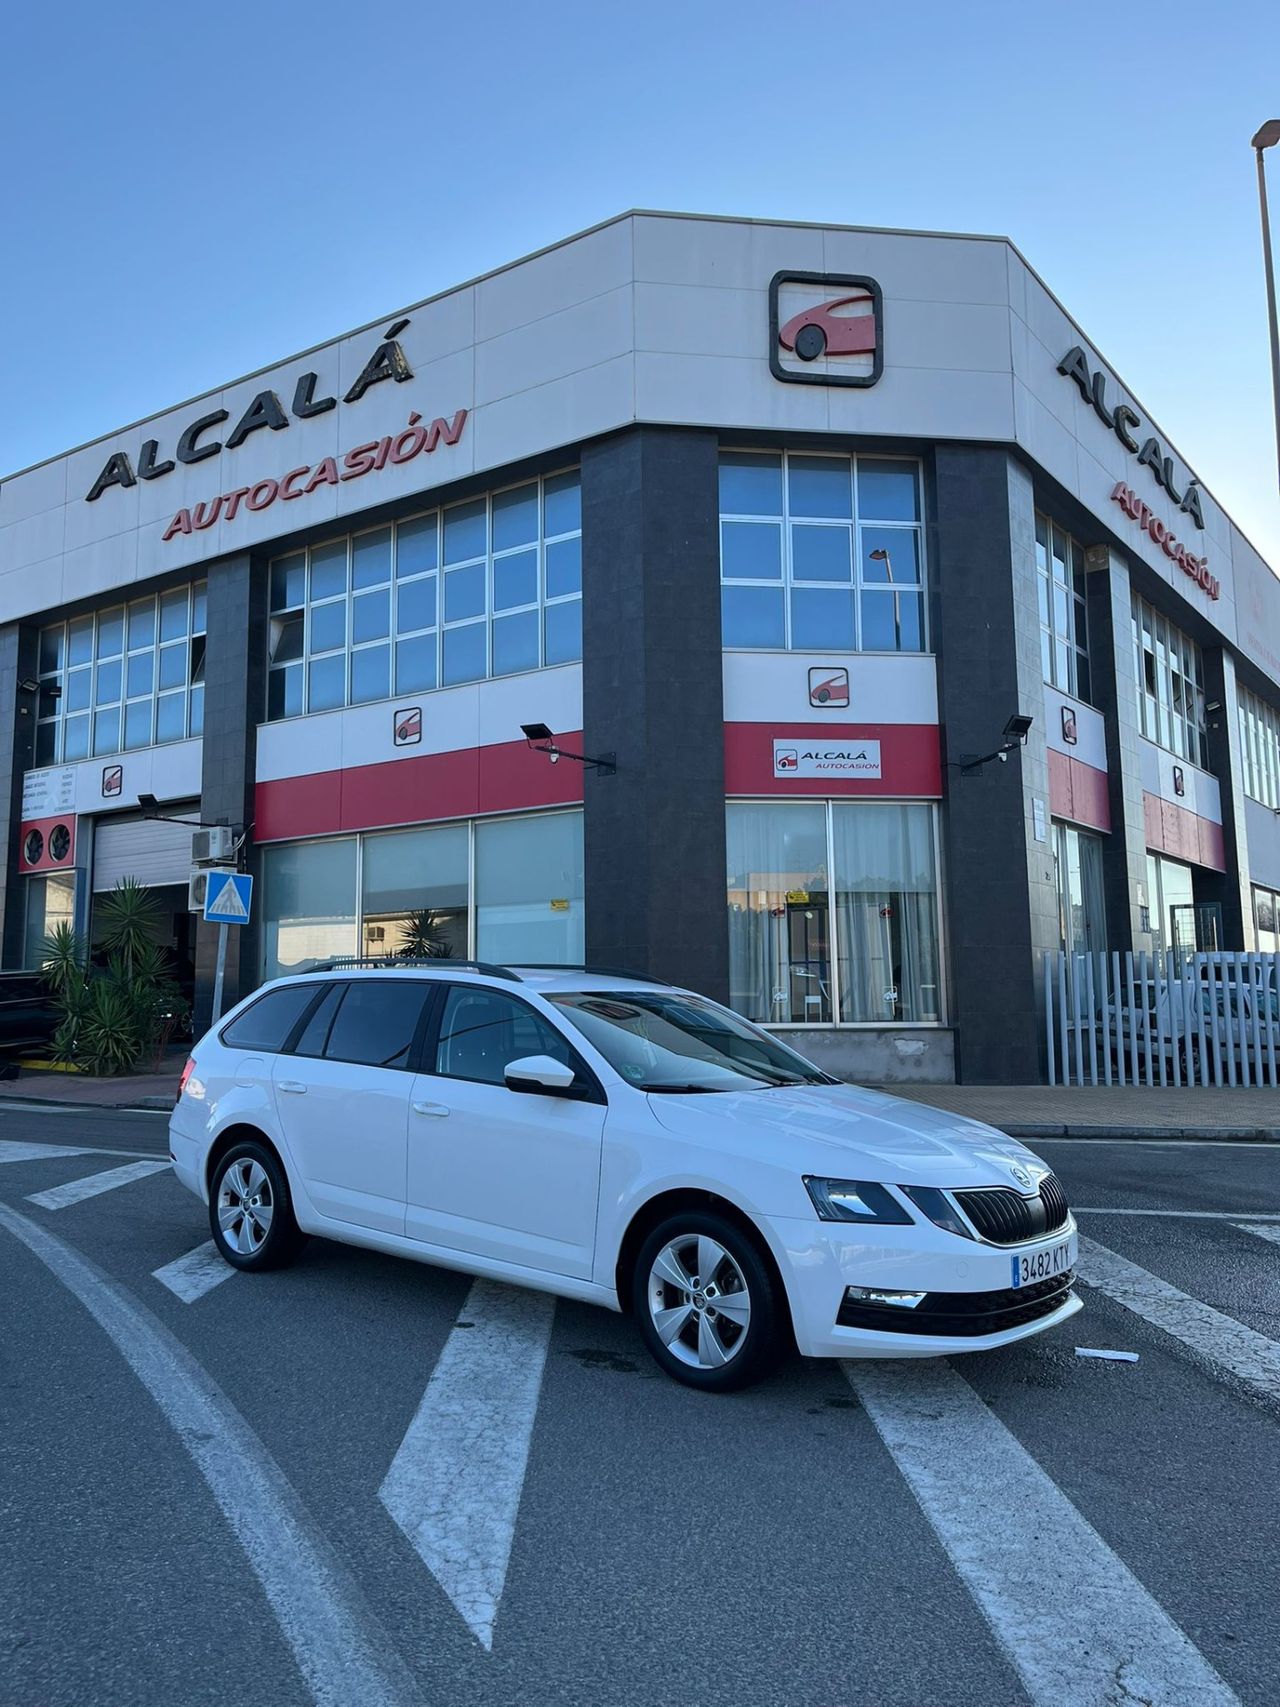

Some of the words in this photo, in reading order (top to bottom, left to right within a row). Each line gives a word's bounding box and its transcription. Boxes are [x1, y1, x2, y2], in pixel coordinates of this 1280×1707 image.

[85, 318, 415, 502] ALCALÁ
[161, 408, 469, 541] AUTOCASIÓN
[1056, 346, 1205, 530] ALCALÁ
[1110, 481, 1220, 601] AUTOCASIÓN
[1021, 1251, 1051, 1282] 3482
[1053, 1243, 1069, 1273] KTY
